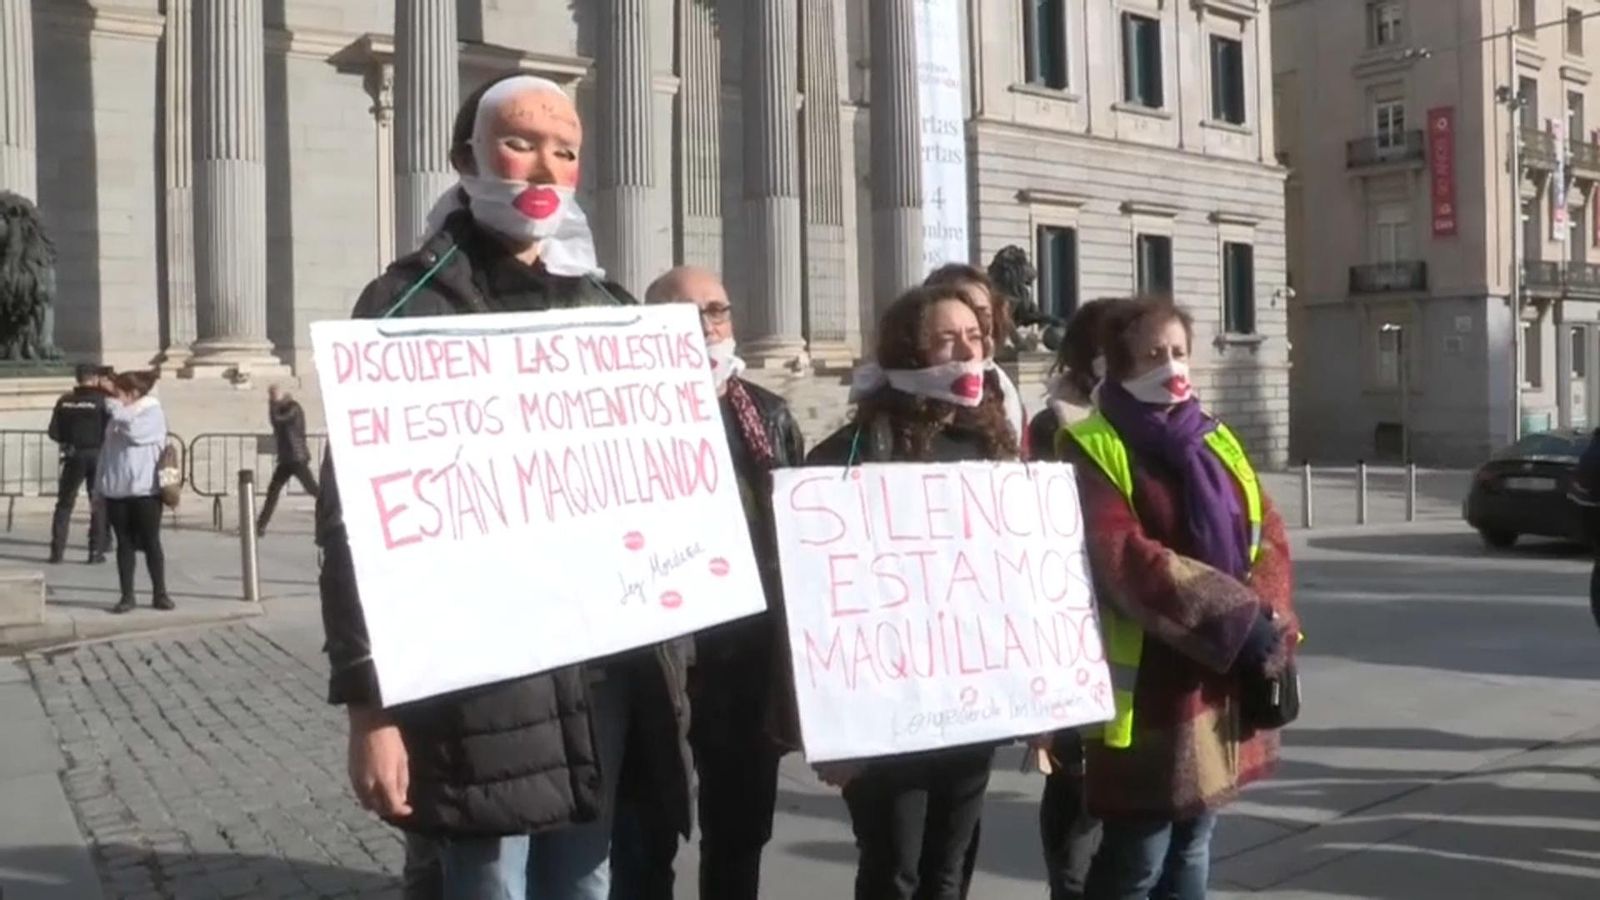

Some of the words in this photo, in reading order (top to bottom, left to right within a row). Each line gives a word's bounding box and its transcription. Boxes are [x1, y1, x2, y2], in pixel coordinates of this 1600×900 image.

[333, 339, 491, 383] DISCULPEN
[515, 334, 570, 374] LAS
[349, 407, 391, 446] EN
[404, 397, 504, 442] ESTOS
[520, 383, 671, 433] MOMENTOS
[676, 381, 711, 424] ME
[370, 445, 508, 550] ESTÁN
[514, 438, 718, 524] MAQUILLANDO
[829, 550, 1094, 617] ESTAMOS
